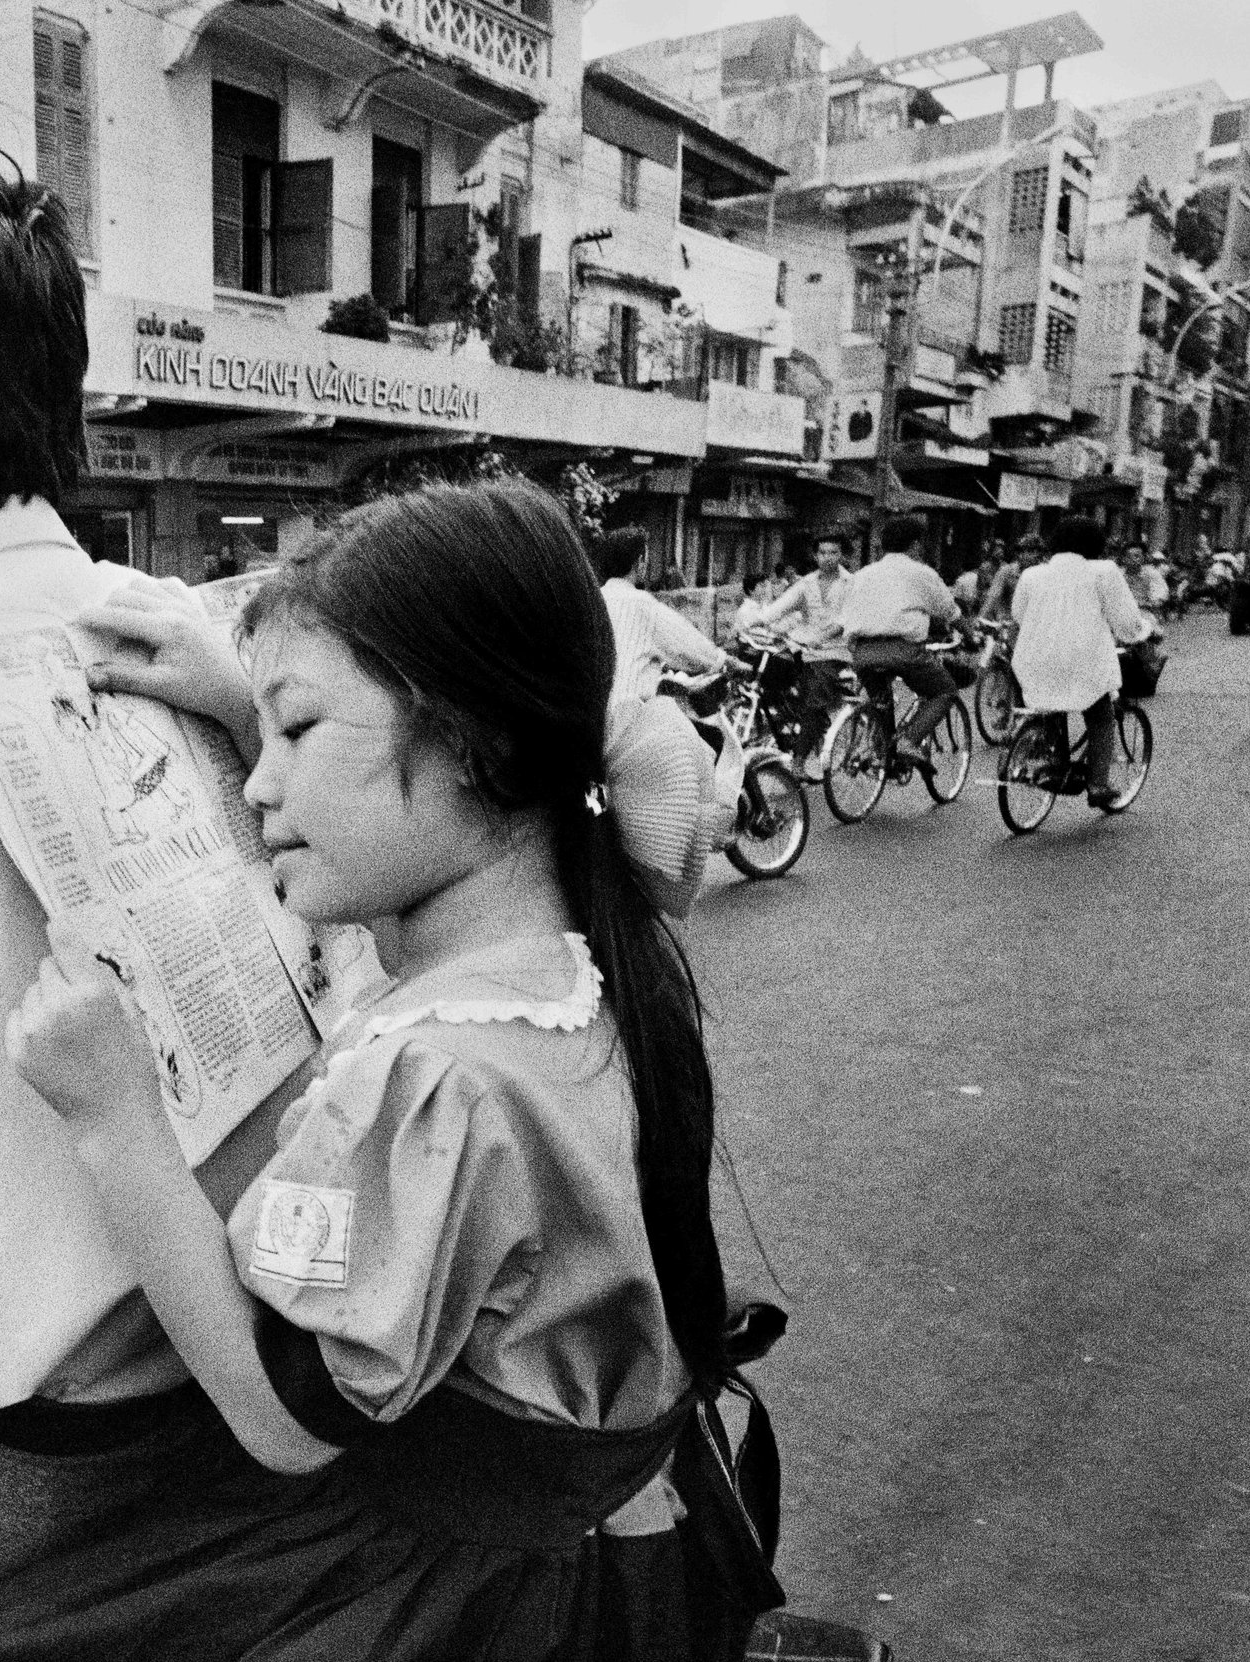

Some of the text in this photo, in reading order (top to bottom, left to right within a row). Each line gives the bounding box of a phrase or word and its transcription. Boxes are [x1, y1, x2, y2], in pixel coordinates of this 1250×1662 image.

[136, 344, 202, 387] KINH
[209, 353, 299, 398] DOANH
[305, 360, 369, 406] VÀNG
